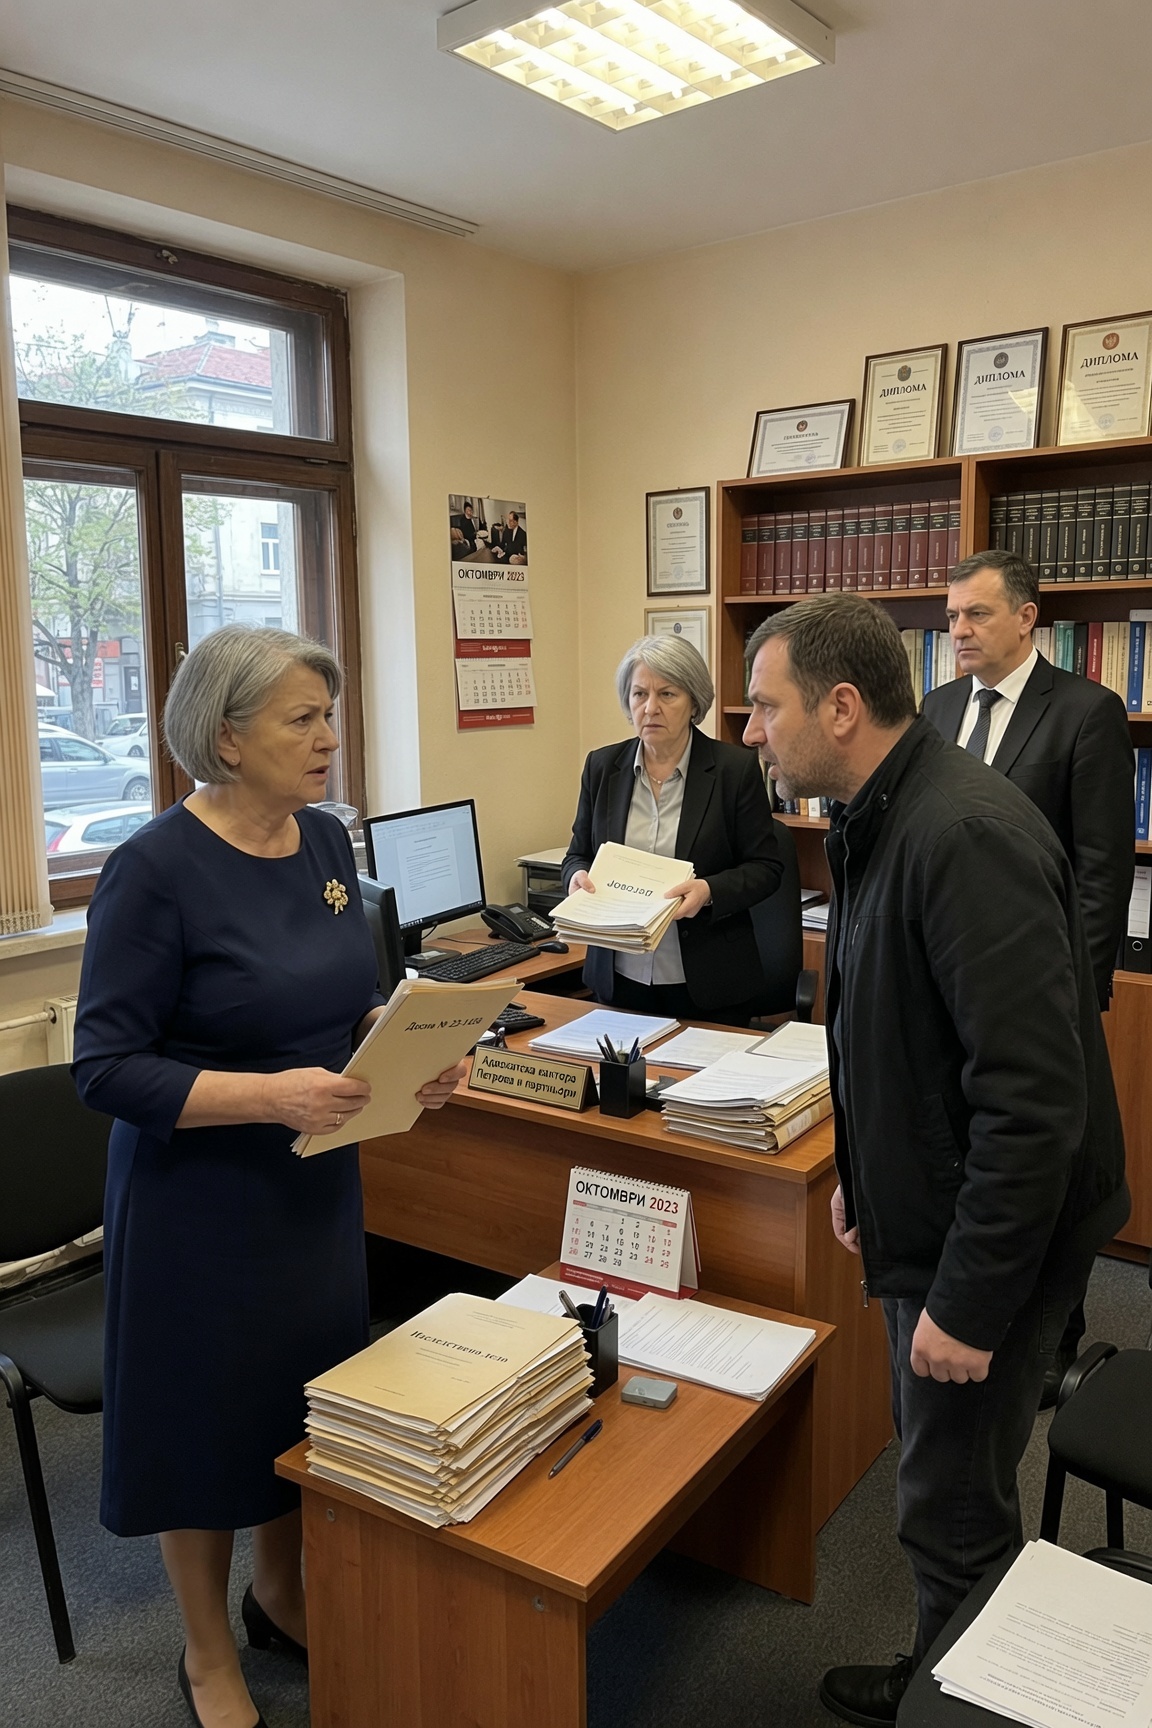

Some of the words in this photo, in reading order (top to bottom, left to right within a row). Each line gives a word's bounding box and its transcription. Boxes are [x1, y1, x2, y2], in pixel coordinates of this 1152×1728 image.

[1080, 351, 1139, 369] ДИПЛОМА
[973, 370, 1026, 385] ДИПЛОМА
[879, 383, 927, 399] ДИПЛОМА
[575, 1180, 646, 1207] ОКТОМВРИ
[649, 1196, 679, 1214] 2023
